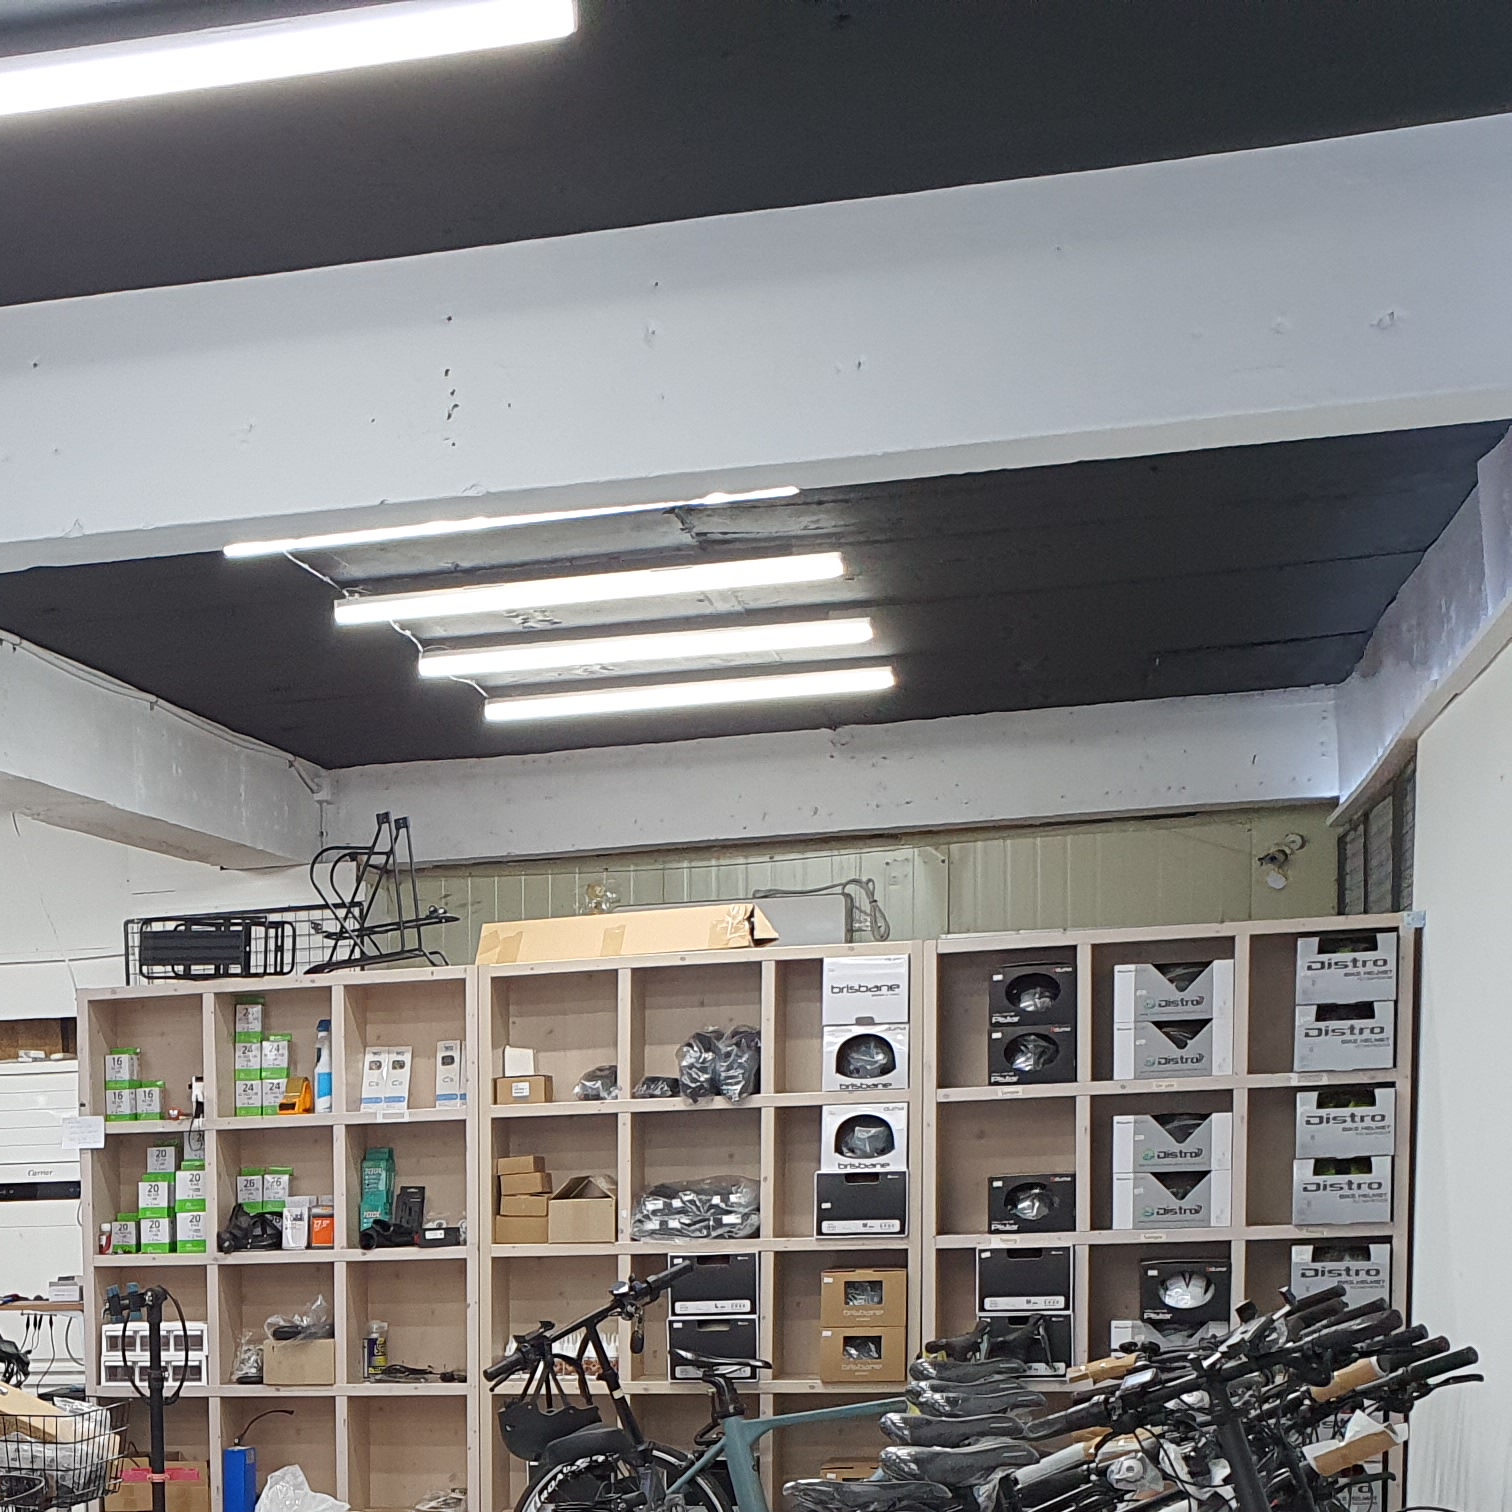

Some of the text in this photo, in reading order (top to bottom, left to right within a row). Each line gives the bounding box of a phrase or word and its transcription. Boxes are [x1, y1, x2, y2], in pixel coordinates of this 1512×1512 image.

[1306, 957, 1388, 972] Distro
[831, 983, 901, 994] brisbane
[1157, 995, 1205, 1008] Distro
[1303, 1024, 1385, 1038] Distro
[112, 1056, 123, 1066] 16
[1157, 1052, 1205, 1066] Distro
[242, 1083, 254, 1093] 24
[269, 1081, 281, 1091] 24
[839, 1082, 893, 1090] brisbane
[113, 1091, 124, 1101] 16
[143, 1089, 154, 1099] 16
[1305, 1112, 1386, 1126] Distro
[155, 1149, 167, 1159] 20
[1157, 1147, 1203, 1160] Distro
[837, 1162, 891, 1170] brisbane
[28, 1169, 53, 1177] Carrier
[189, 1173, 201, 1183] 20
[148, 1183, 160, 1193] 20
[243, 1178, 255, 1188] 26
[1302, 1179, 1383, 1193] Distro
[1156, 1204, 1202, 1216] Distro
[189, 1214, 201, 1224] 20
[118, 1222, 128, 1232] 20
[148, 1220, 161, 1229] 20
[1300, 1266, 1381, 1279] Distro
